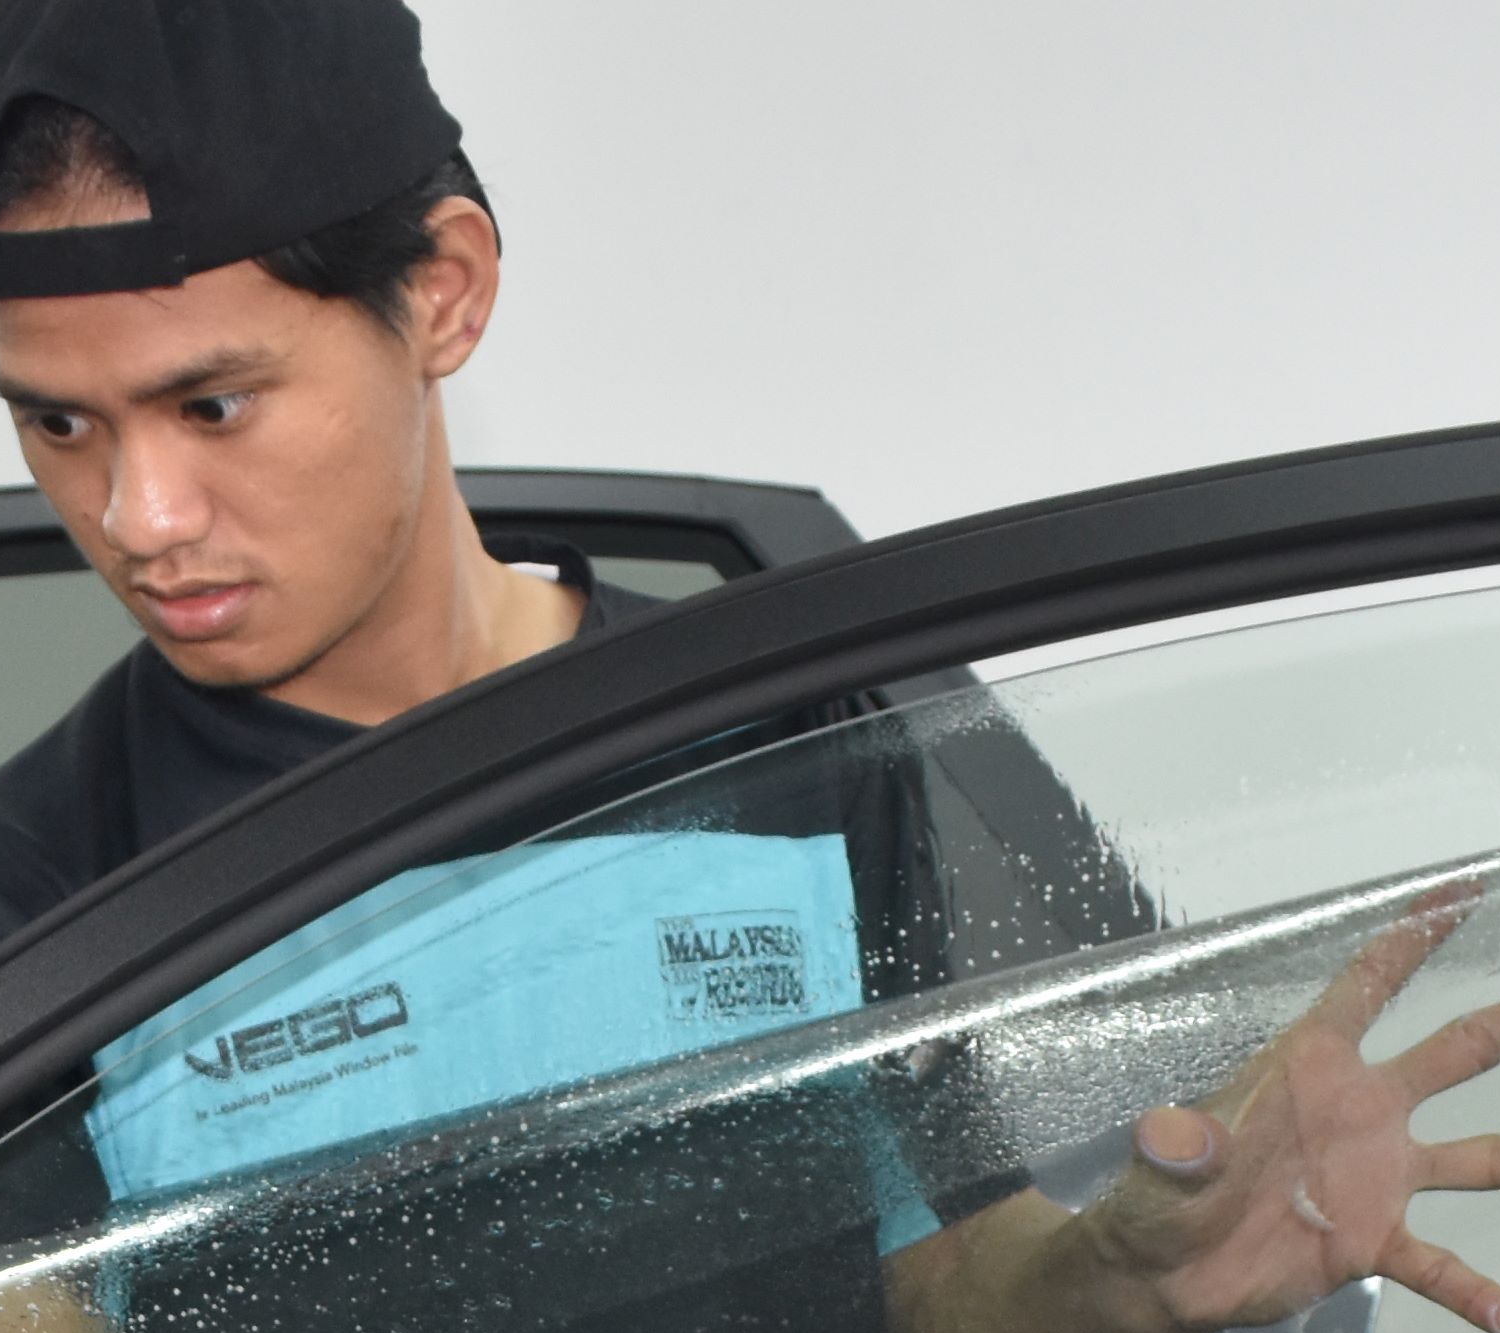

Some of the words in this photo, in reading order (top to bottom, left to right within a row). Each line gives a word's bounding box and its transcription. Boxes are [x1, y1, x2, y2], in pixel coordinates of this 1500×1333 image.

[184, 980, 408, 1081] VEGO
[271, 1071, 334, 1097] Malaysia
[333, 1053, 391, 1078] Window
